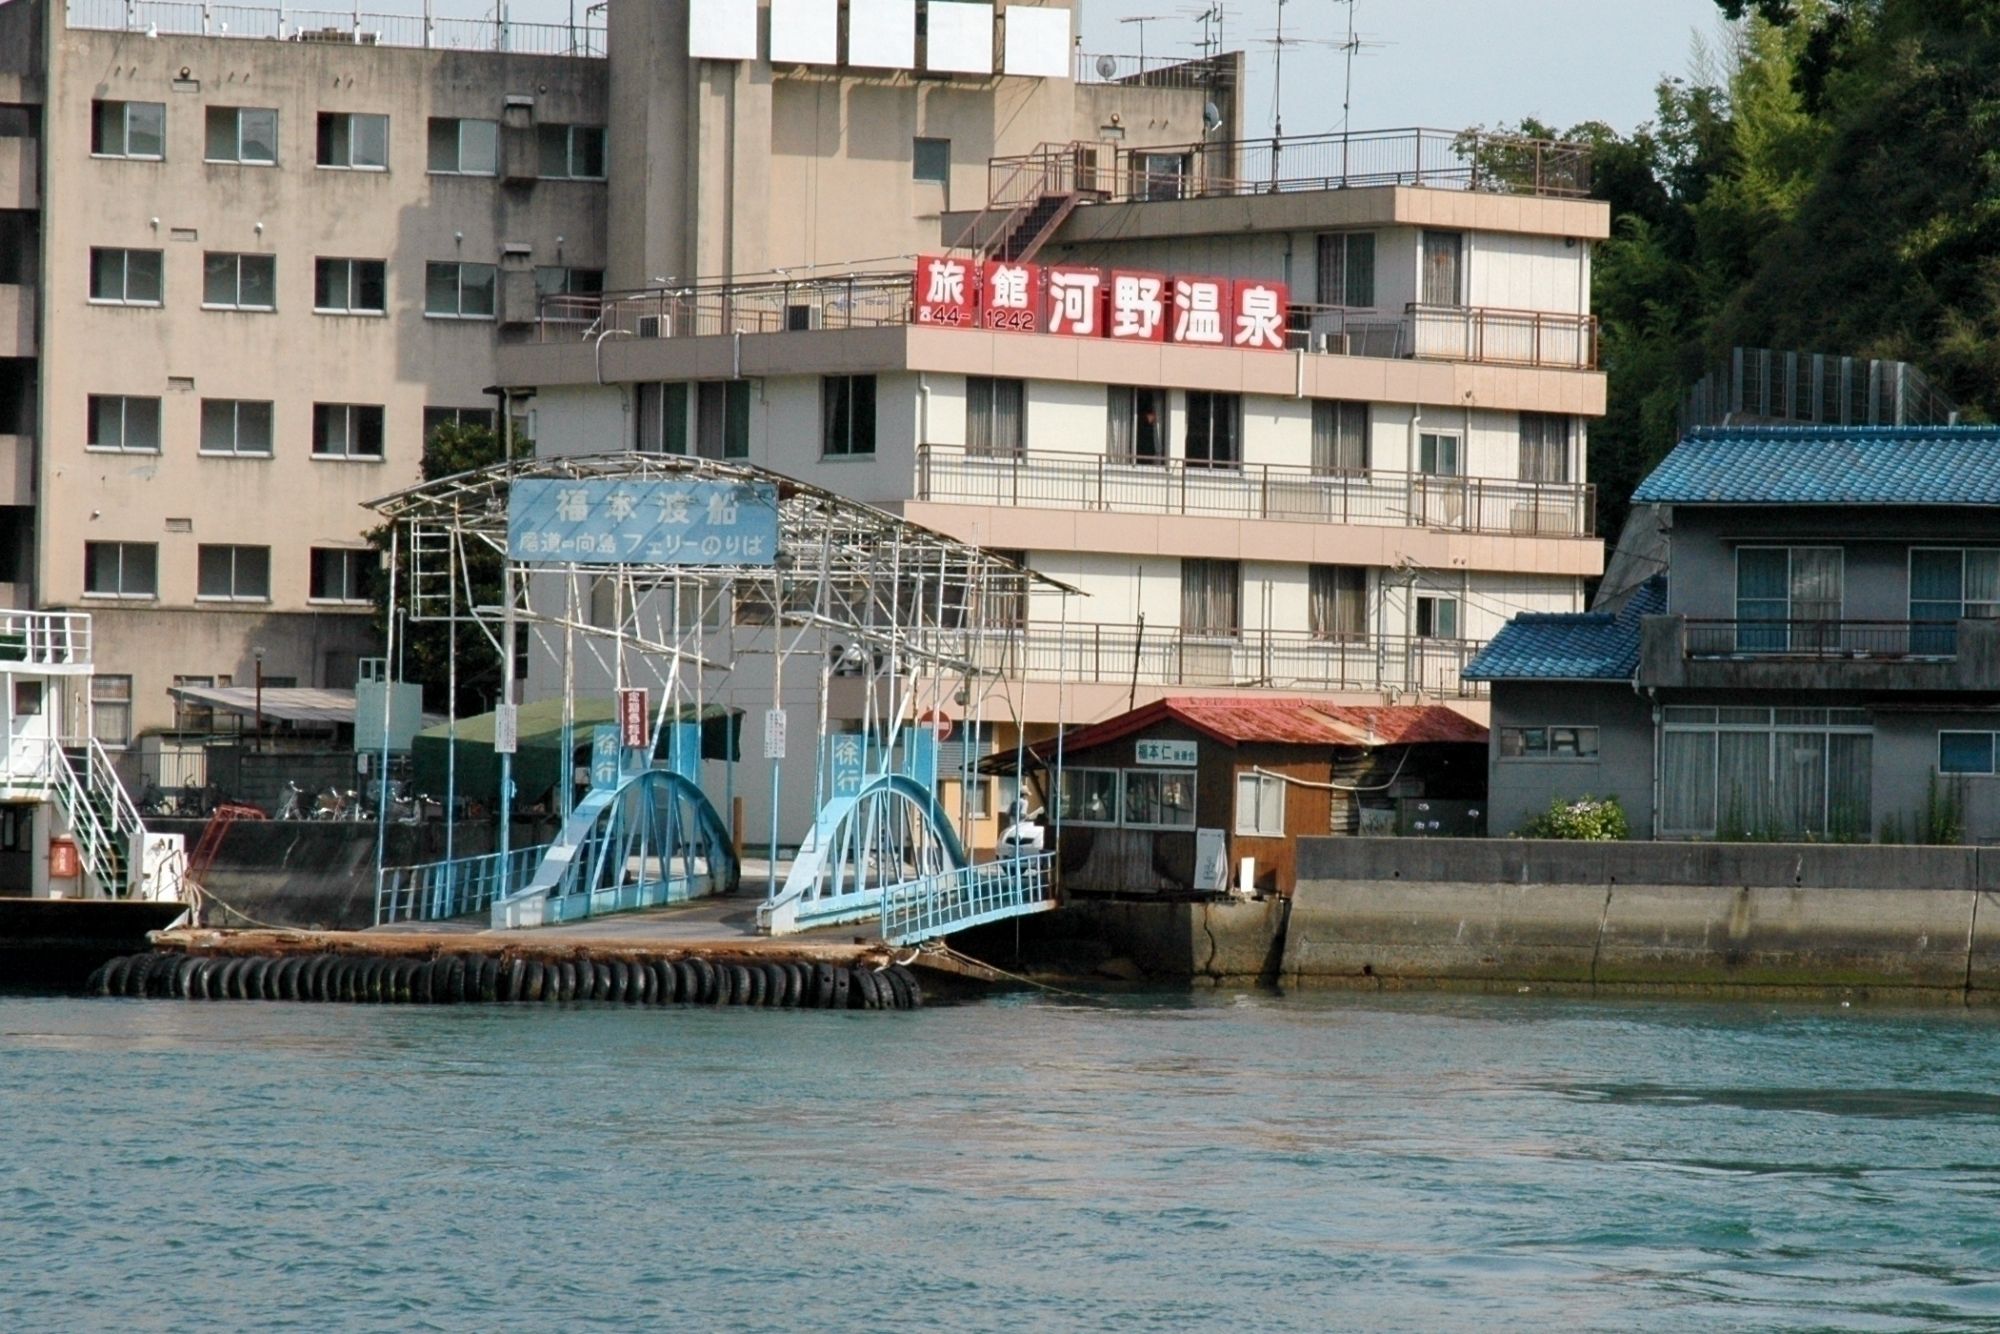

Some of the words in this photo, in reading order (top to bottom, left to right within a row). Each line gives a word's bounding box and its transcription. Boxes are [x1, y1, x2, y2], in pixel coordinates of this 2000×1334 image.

[556, 489, 740, 525] 福本渡船
[595, 734, 619, 783] 徐行
[834, 740, 859, 792] 徐行
